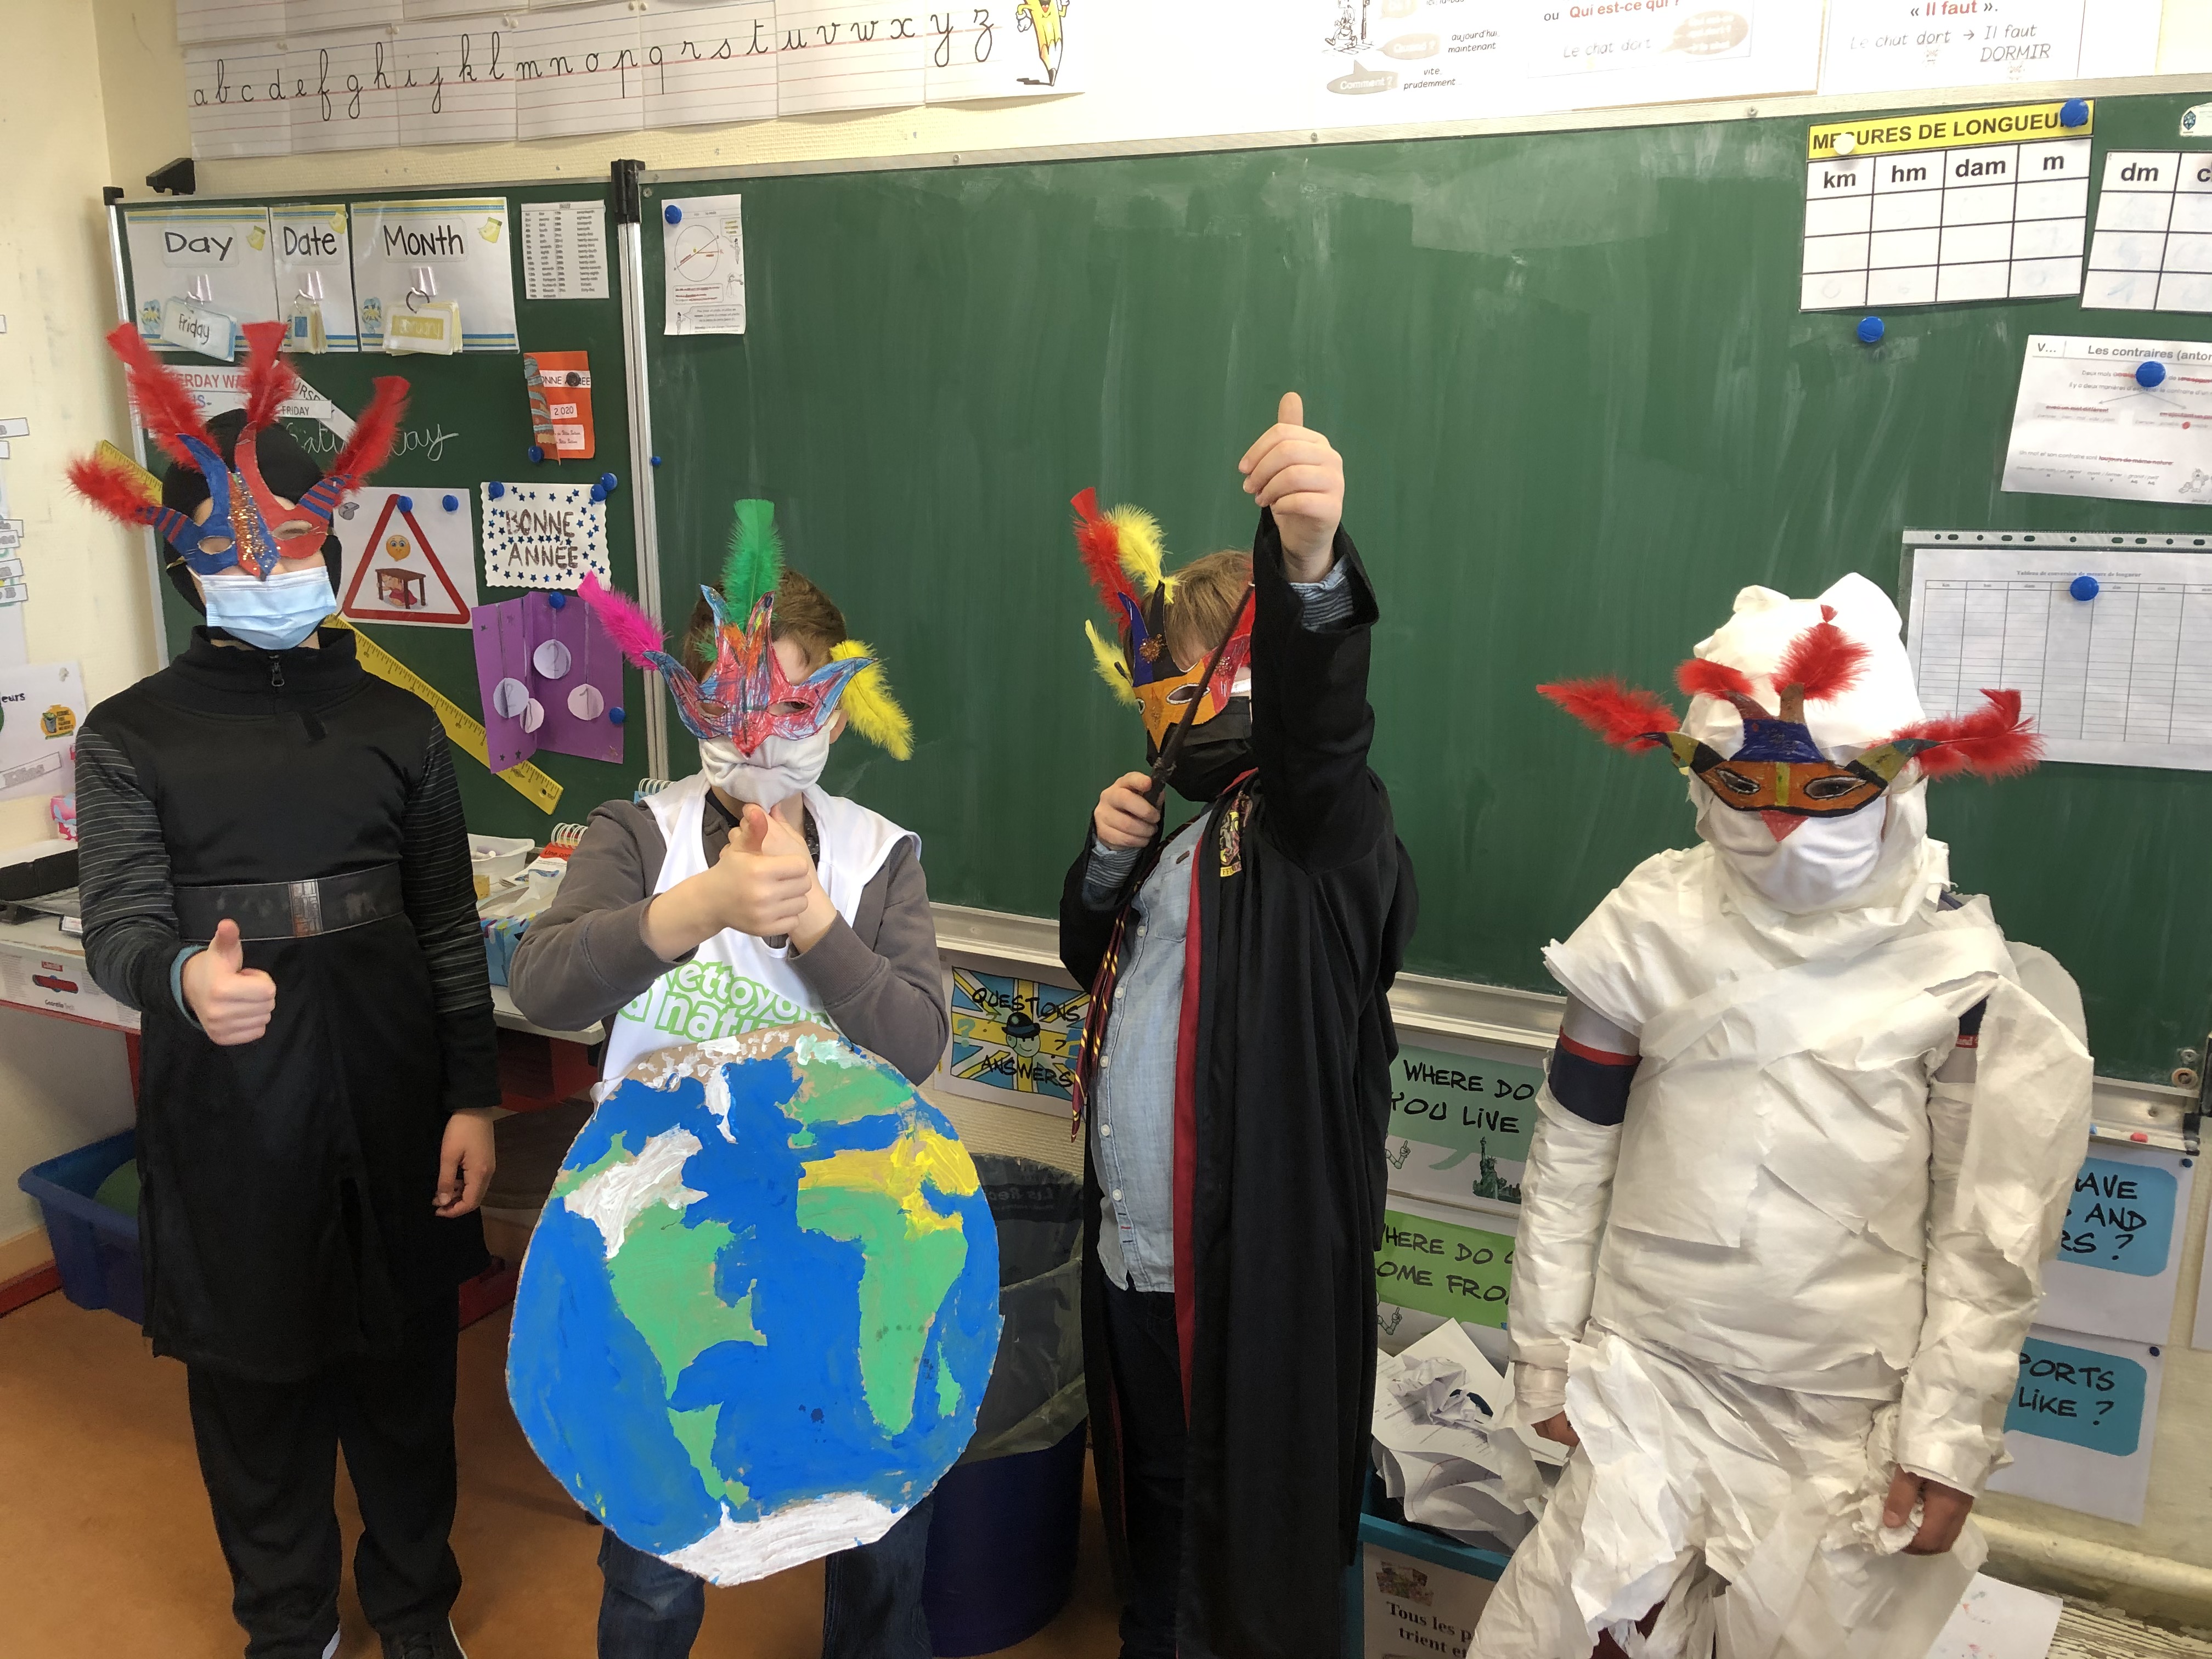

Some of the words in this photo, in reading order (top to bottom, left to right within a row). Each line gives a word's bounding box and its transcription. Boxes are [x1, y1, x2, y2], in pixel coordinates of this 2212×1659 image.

[1544, 12, 1560, 21] ou
[1570, 4, 1593, 18] Qui
[1597, 1, 1642, 15] est-ce
[1926, 2, 1936, 16] Il
[1942, 1, 1977, 15] faut
[1875, 33, 1909, 48] chat
[1916, 30, 1952, 45] dort
[2005, 24, 2037, 38] faut
[1448, 42, 1497, 54] maintenant
[1979, 43, 2051, 63] DORMIR
[194, 89, 207, 106] a
[216, 59, 230, 103] b
[242, 85, 253, 102] c
[269, 69, 285, 100] d
[296, 79, 307, 97] e
[318, 49, 331, 121] f
[347, 75, 363, 119] g
[374, 42, 391, 89] h
[405, 55, 416, 87] i
[430, 52, 443, 114] j
[459, 34, 477, 82] k
[489, 31, 504, 80] l
[516, 61, 542, 80] m
[550, 57, 573, 76] n
[586, 53, 599, 72] o
[612, 49, 637, 99] p
[650, 46, 664, 94] q
[681, 41, 701, 59] r
[710, 38, 731, 59] s
[746, 19, 768, 55] t
[781, 29, 807, 50] u
[817, 22, 840, 44] v
[850, 21, 878, 41] w
[890, 18, 915, 39] x
[930, 13, 953, 67] y
[974, 9, 994, 62] z
[1813, 126, 1911, 150] MEURES
[1919, 122, 1946, 140] DE
[1954, 109, 2088, 136] LONGUEU
[1824, 171, 1857, 189] km
[1892, 165, 1927, 183] hm
[1955, 159, 2006, 177] dam
[2043, 155, 2064, 171] m
[2120, 162, 2159, 182] dm
[165, 231, 234, 261] Day
[283, 225, 338, 256] Date
[383, 224, 465, 257] Month
[178, 313, 211, 346] Friday
[2087, 345, 2109, 356] Les
[2112, 347, 2173, 359] contraires
[281, 405, 310, 416] FRIDAY
[505, 509, 576, 538] BONNE
[507, 541, 579, 571] ANNÉE
[1, 693, 26, 703] eurs
[981, 1055, 1073, 1087] ANSWERS
[1403, 1059, 1484, 1093] WHERE
[1494, 1079, 1534, 1101] DO
[2084, 1203, 2147, 1232] AND
[1384, 1223, 1445, 1255] HERE
[1454, 1243, 1494, 1265] DO
[1376, 1262, 1433, 1287] OME
[1446, 1275, 1509, 1306] FRO
[2019, 1352, 2115, 1392] PORTS
[1386, 1600, 1427, 1626] Tous
[1432, 1616, 1455, 1635] les
[1400, 1627, 1447, 1654] trient
